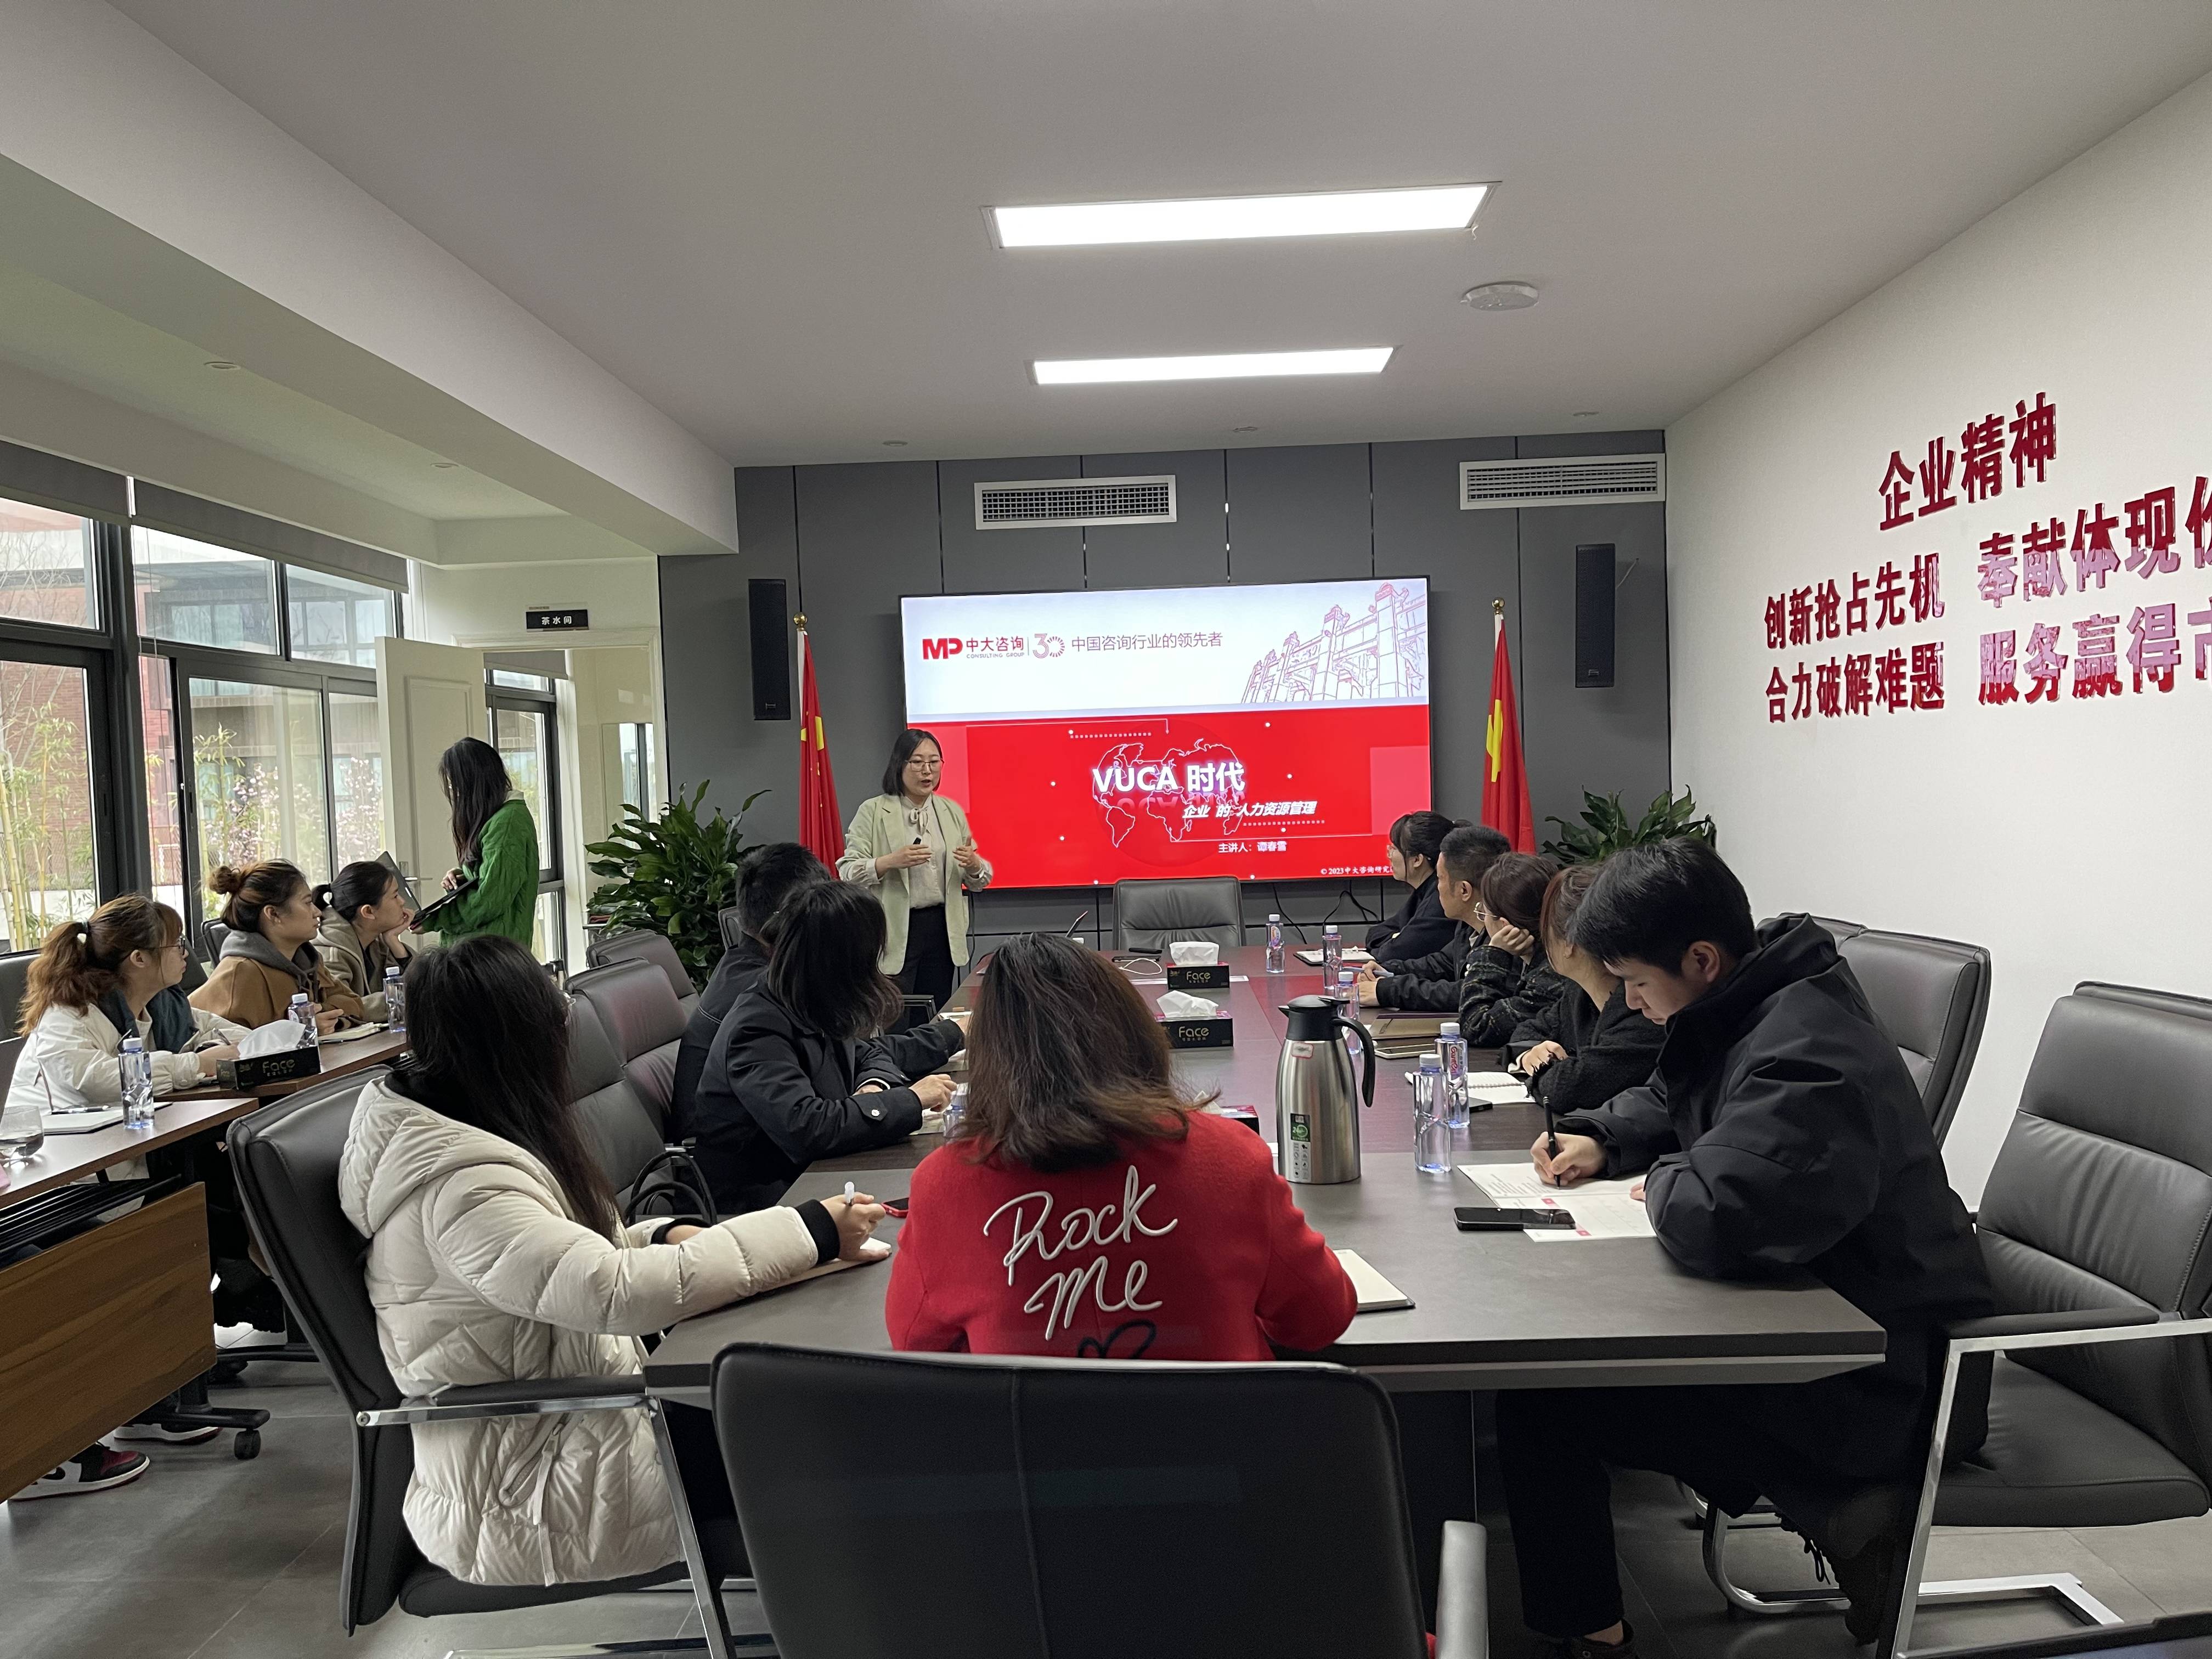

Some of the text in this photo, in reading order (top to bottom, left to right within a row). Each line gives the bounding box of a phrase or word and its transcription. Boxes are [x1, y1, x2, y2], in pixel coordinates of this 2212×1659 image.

[1879, 392, 2057, 531] 企业精神
[1764, 552, 1945, 649] 创新抢占先机
[541, 616, 572, 625] 茶水间
[966, 636, 1024, 652] 中大咨询
[1071, 631, 1223, 652] 中国咨询行业的领先者
[1766, 641, 1945, 723] 合力破解难题
[1092, 763, 1246, 792] VUCA 时代
[1182, 804, 1210, 819] 企业
[1237, 800, 1318, 817] 人力资源管理
[1186, 971, 1211, 981] Face
[1178, 1026, 1210, 1038] Face
[262, 1059, 295, 1074] Face
[983, 1165, 1178, 1287] Rock
